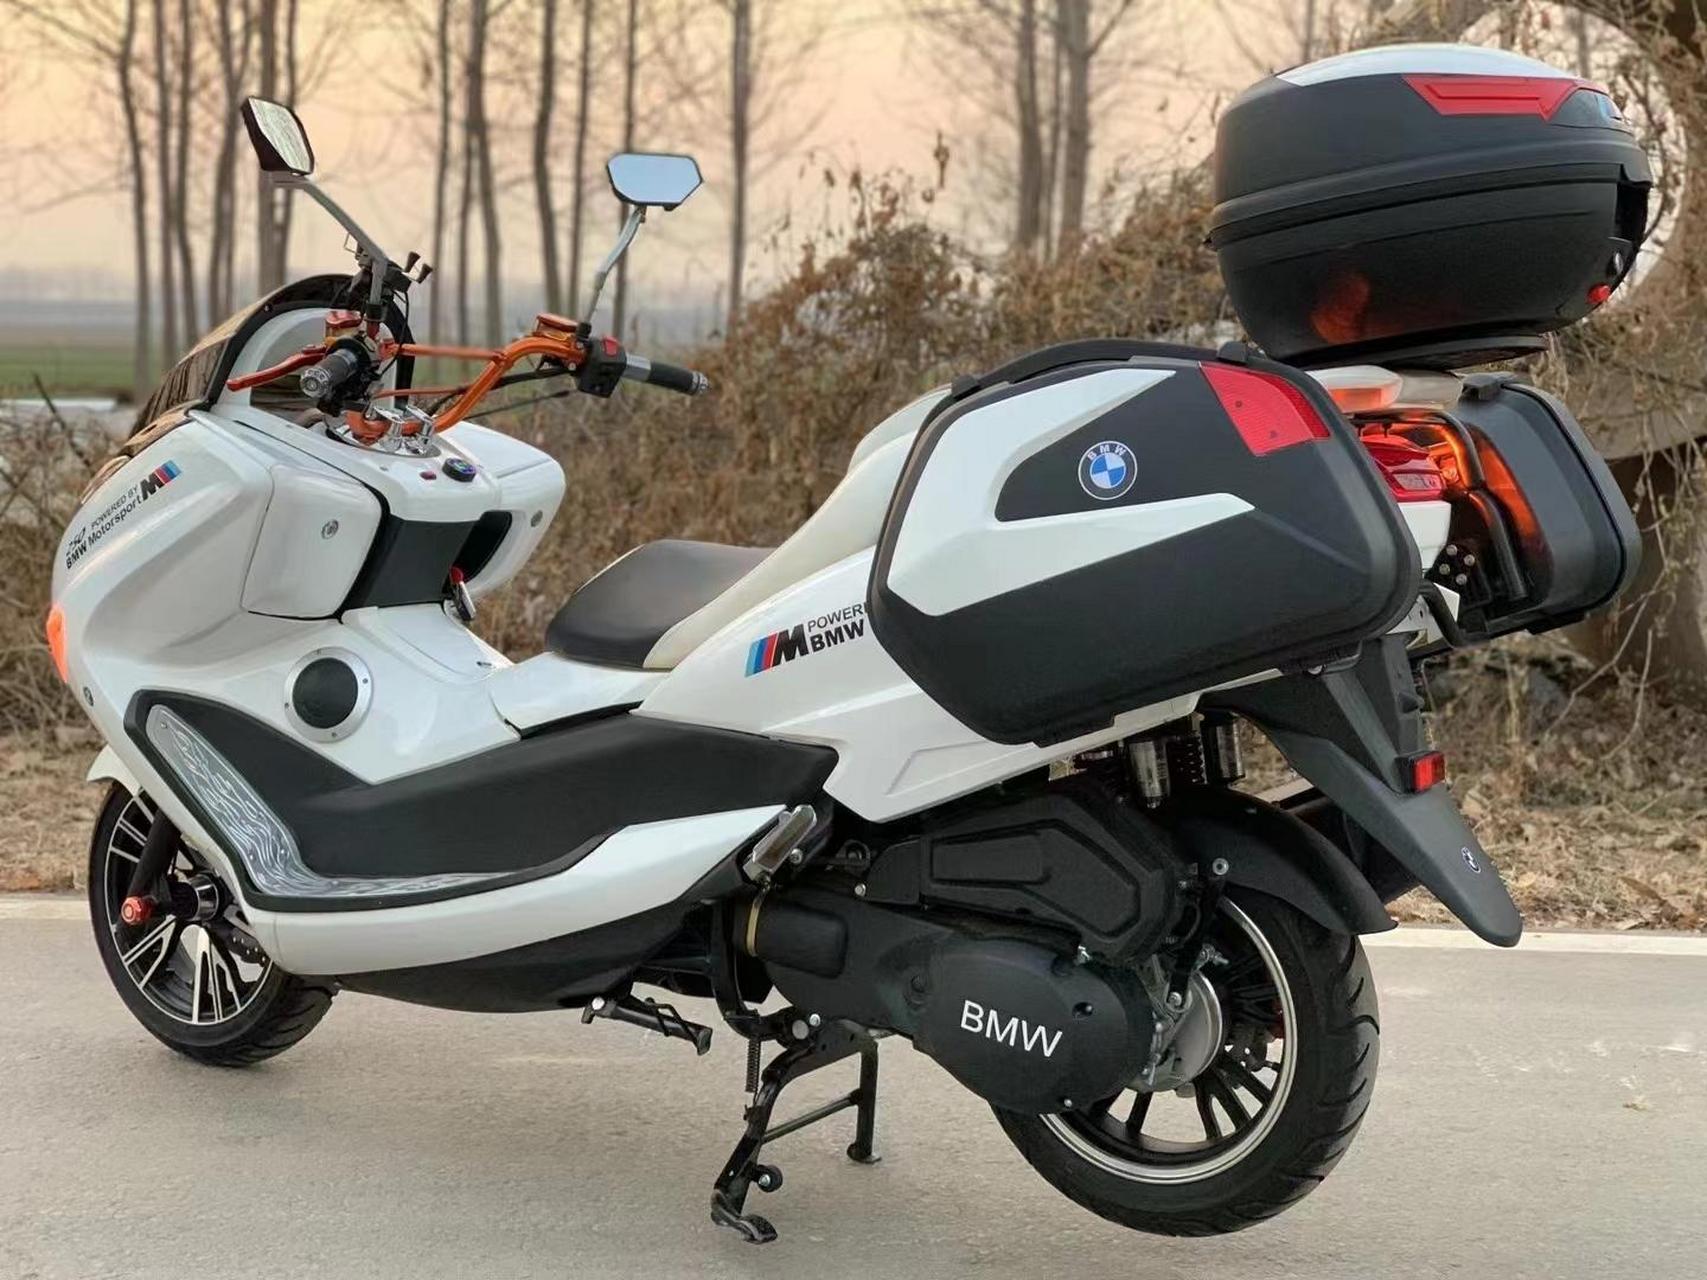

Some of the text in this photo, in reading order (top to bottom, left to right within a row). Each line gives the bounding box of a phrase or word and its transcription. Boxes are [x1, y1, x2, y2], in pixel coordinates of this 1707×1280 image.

[1087, 444, 1127, 461] BMW
[91, 484, 139, 529] POWERED BY
[65, 494, 142, 569] BMW Motorsport
[809, 618, 865, 653] BMW
[960, 999, 1063, 1058] BMW
